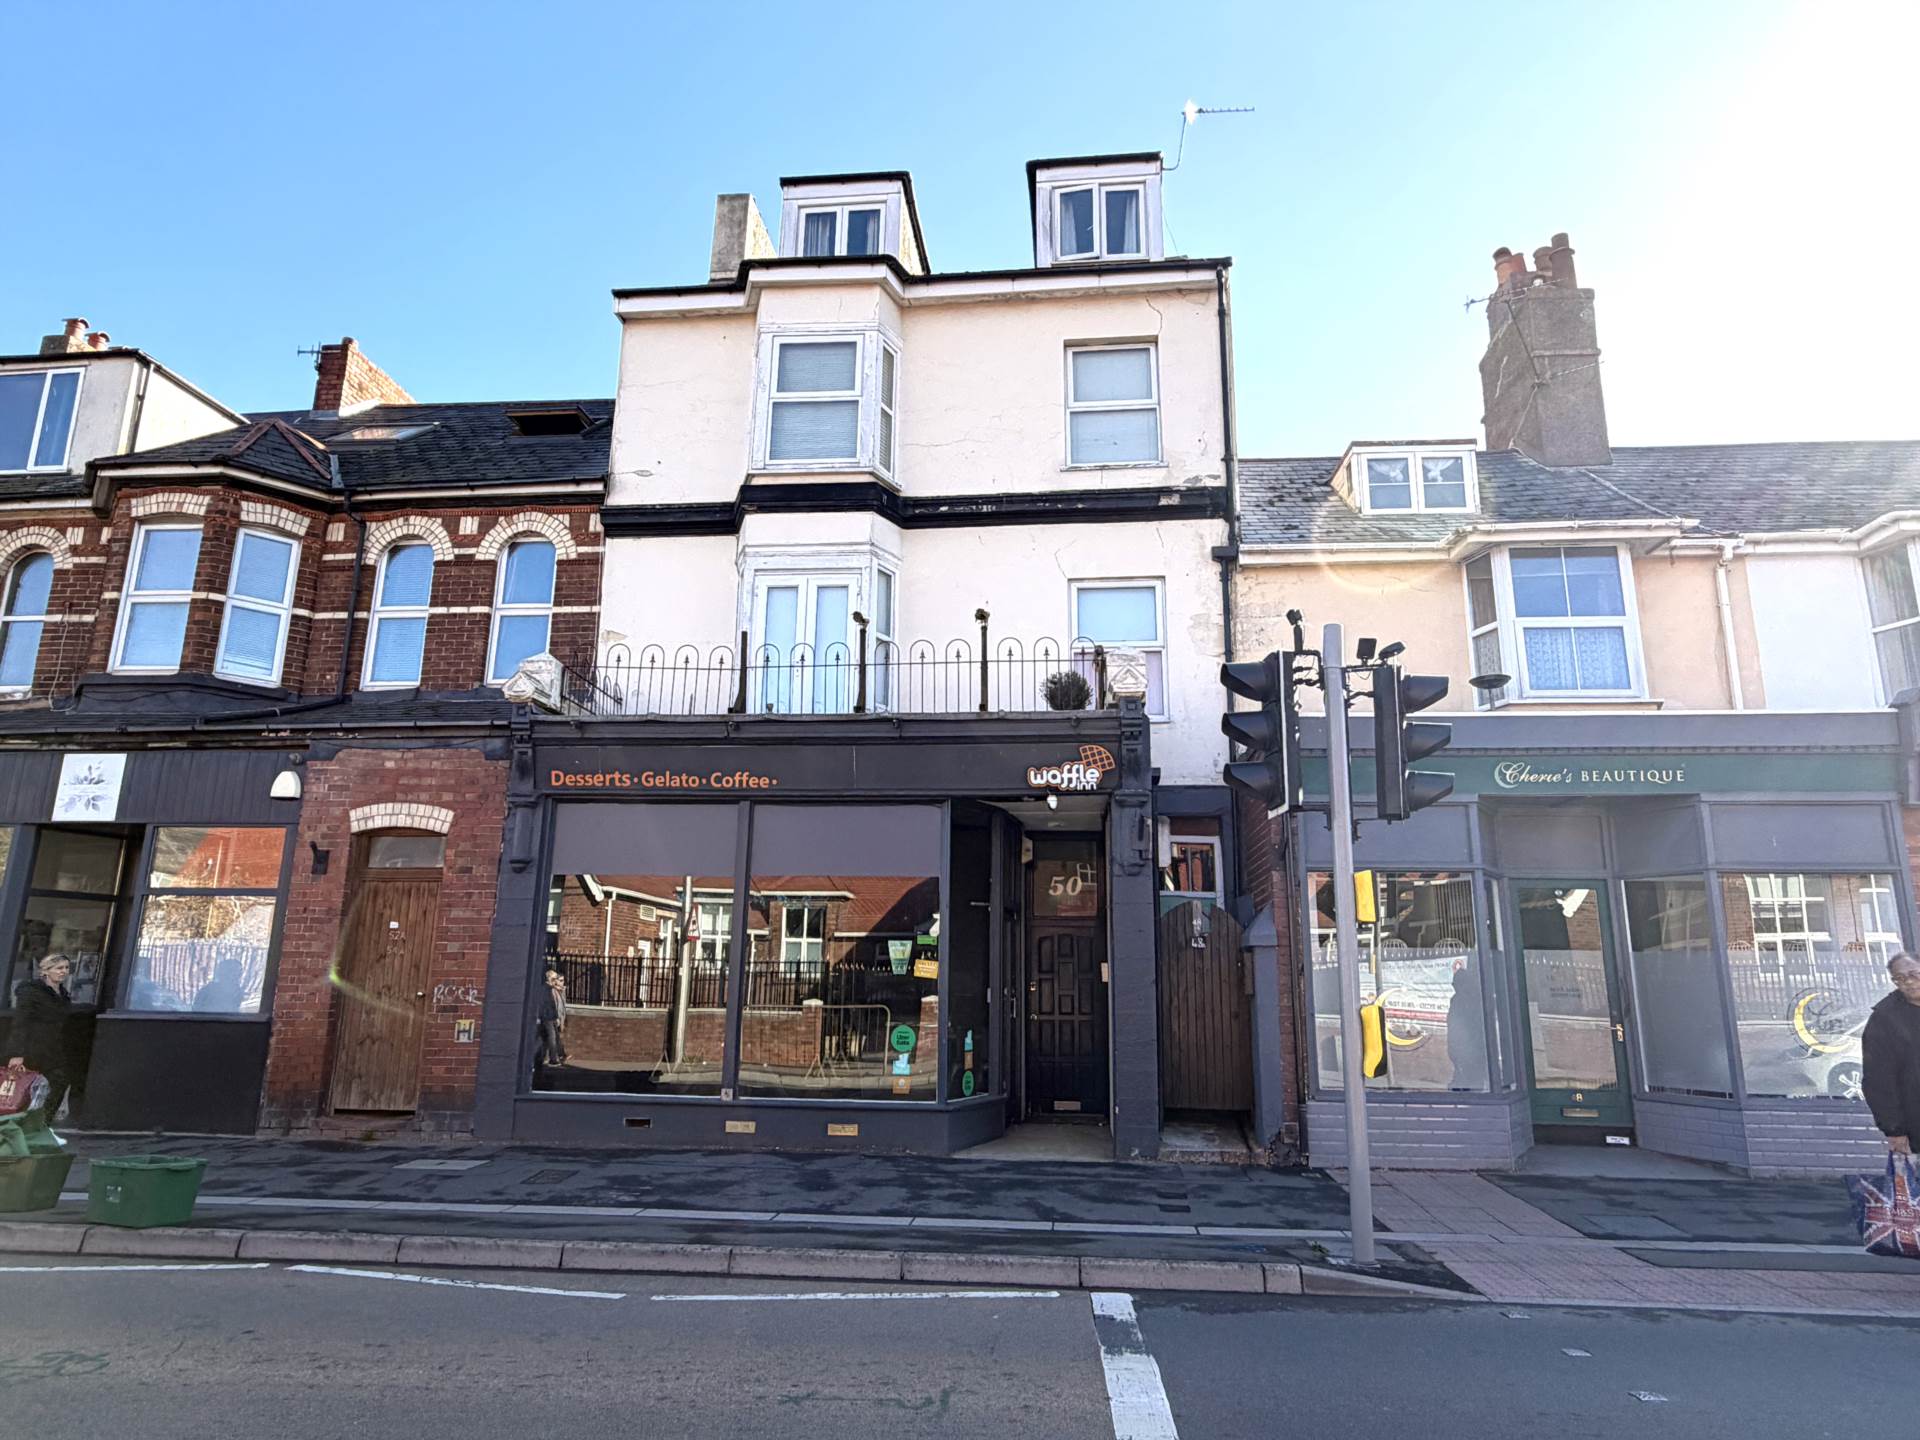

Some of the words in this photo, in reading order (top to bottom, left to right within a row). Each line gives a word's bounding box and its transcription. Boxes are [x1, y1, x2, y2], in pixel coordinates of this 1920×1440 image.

[551, 769, 631, 787] Desserts
[641, 770, 700, 788] Gelato
[710, 771, 770, 789] Coffee
[1029, 764, 1100, 788] waffle
[1076, 780, 1097, 790] inn
[1581, 769, 1685, 784] BEAUTIQUE
[1048, 876, 1083, 896] 50
